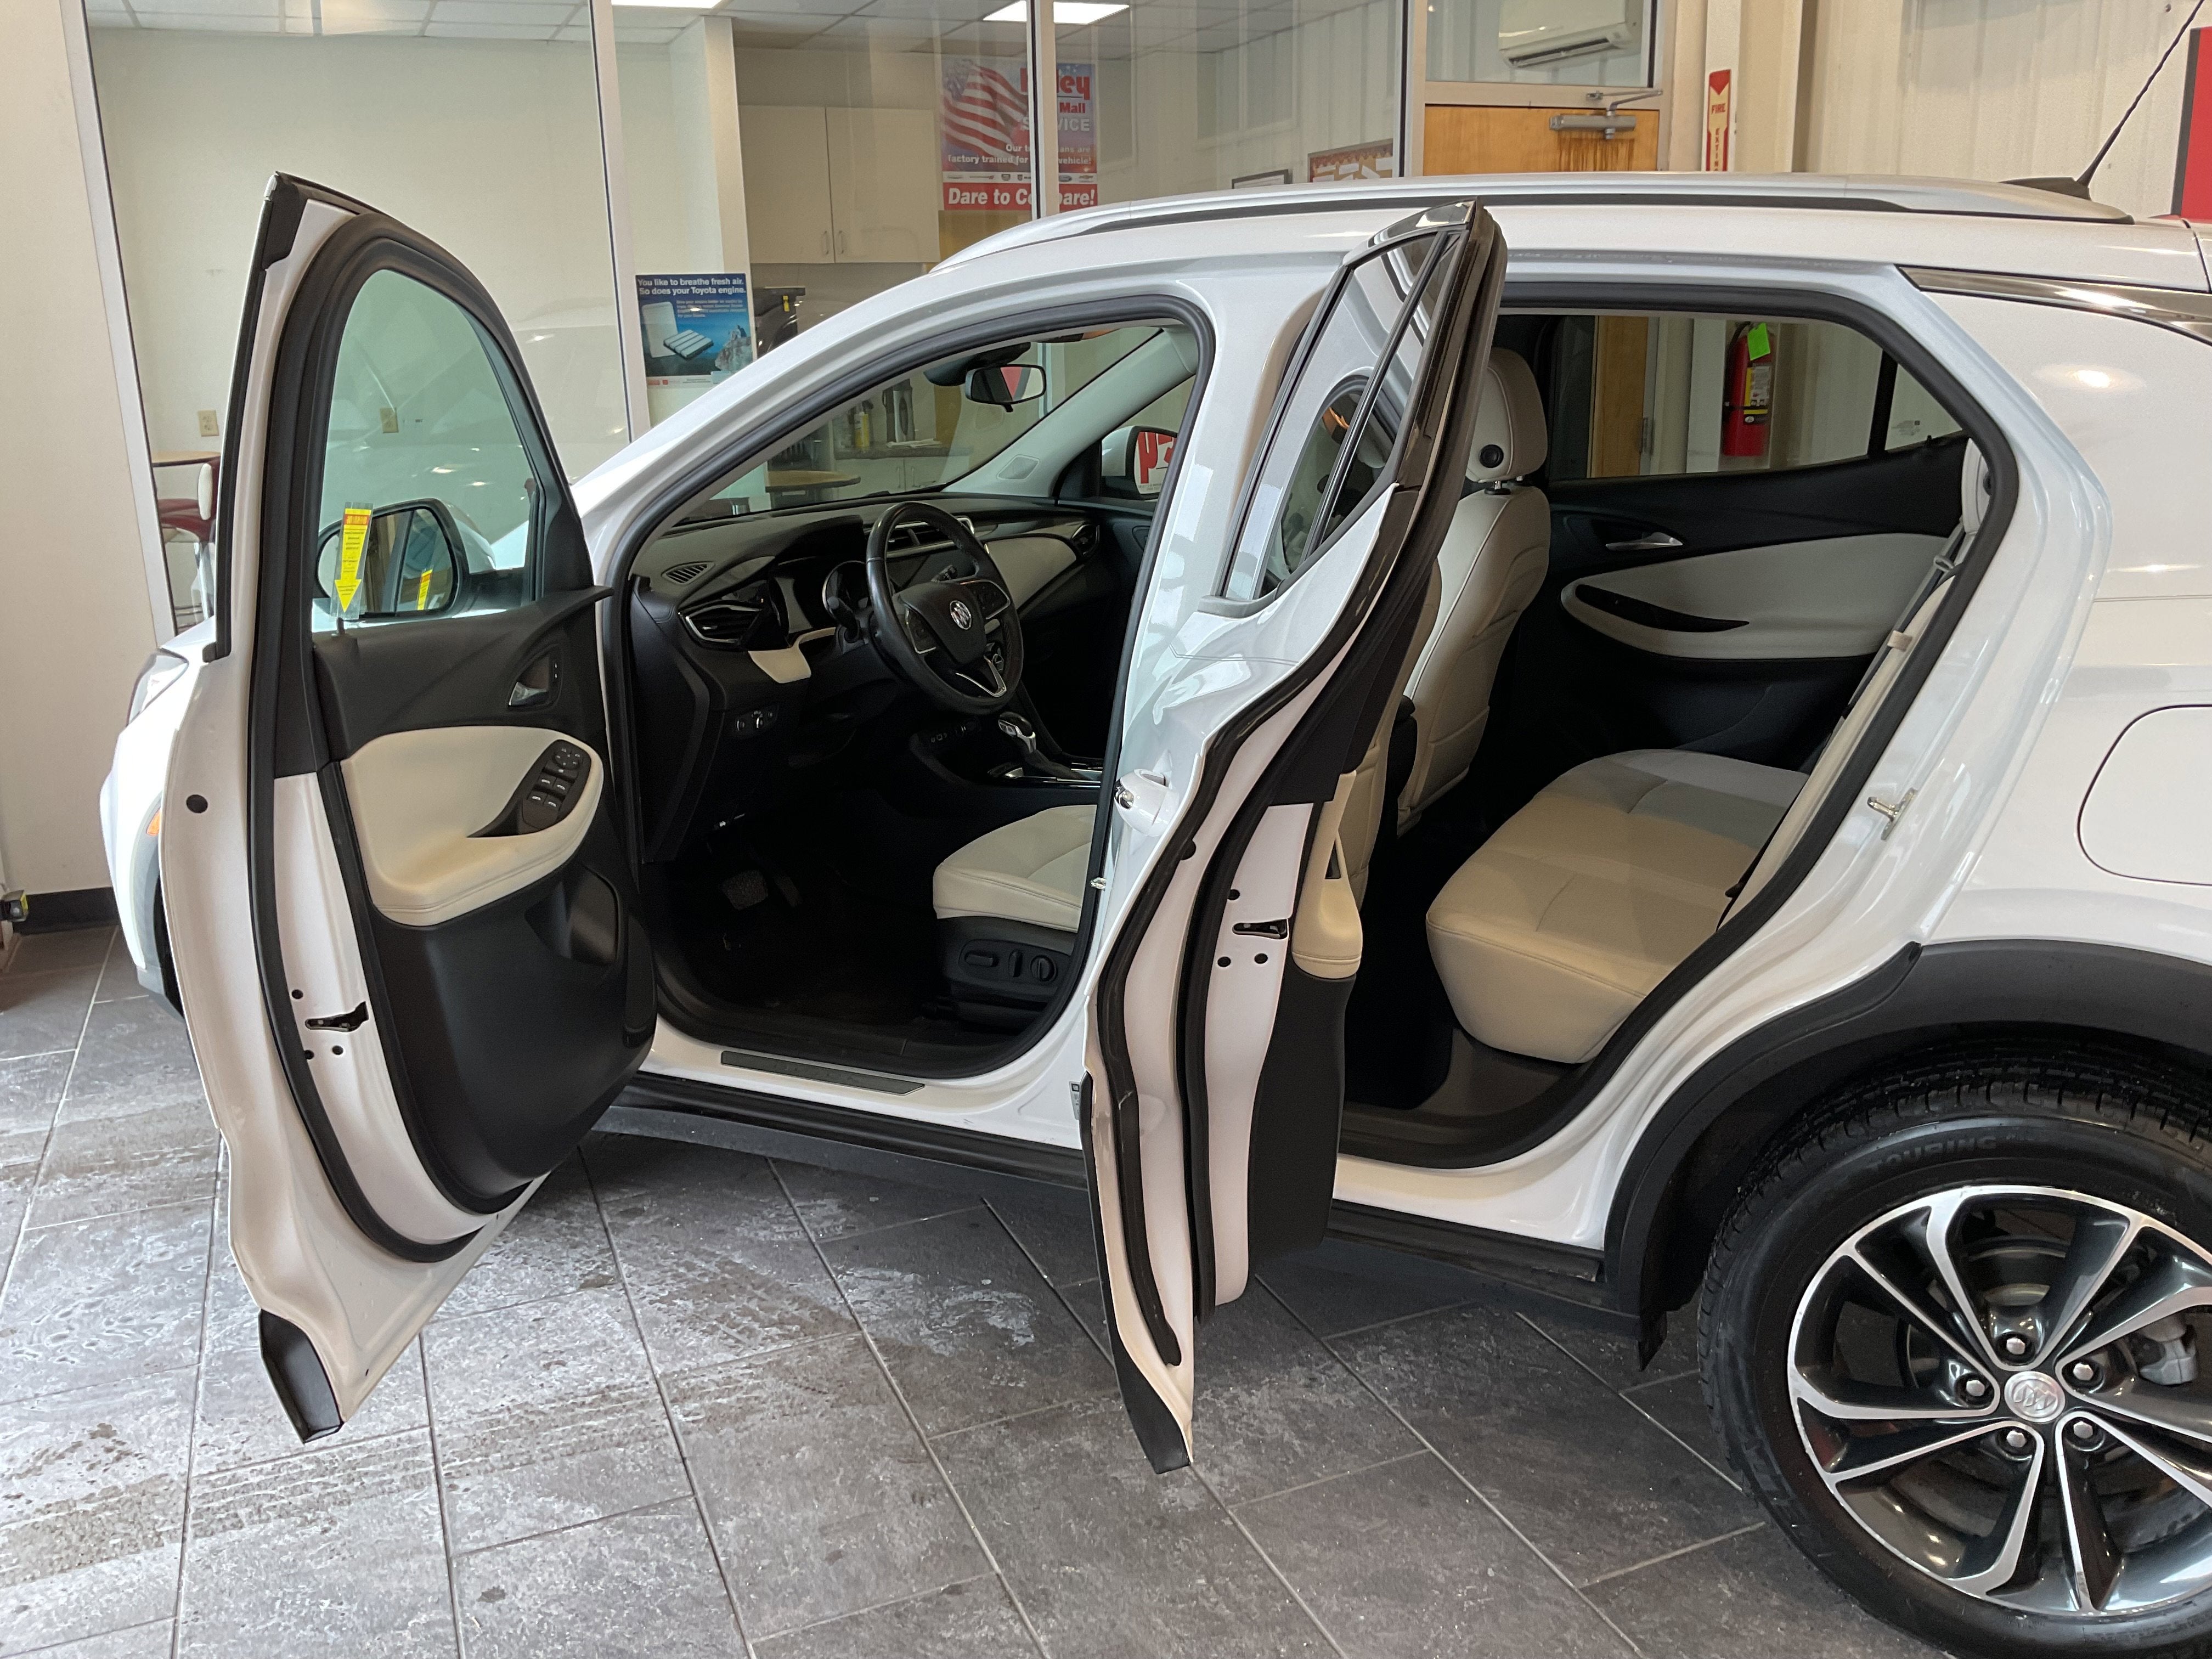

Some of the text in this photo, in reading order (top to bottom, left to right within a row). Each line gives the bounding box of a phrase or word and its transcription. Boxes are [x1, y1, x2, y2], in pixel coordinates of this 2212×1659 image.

[1059, 102, 1086, 114] Mall
[1711, 103, 1726, 115] FIRE
[1006, 144, 1023, 152] Our
[948, 155, 979, 164] factory
[983, 155, 1013, 163] trained
[948, 188, 988, 205] Dare
[994, 189, 1010, 205] to
[691, 286, 716, 295] Toyota
[718, 286, 746, 295] engine.
